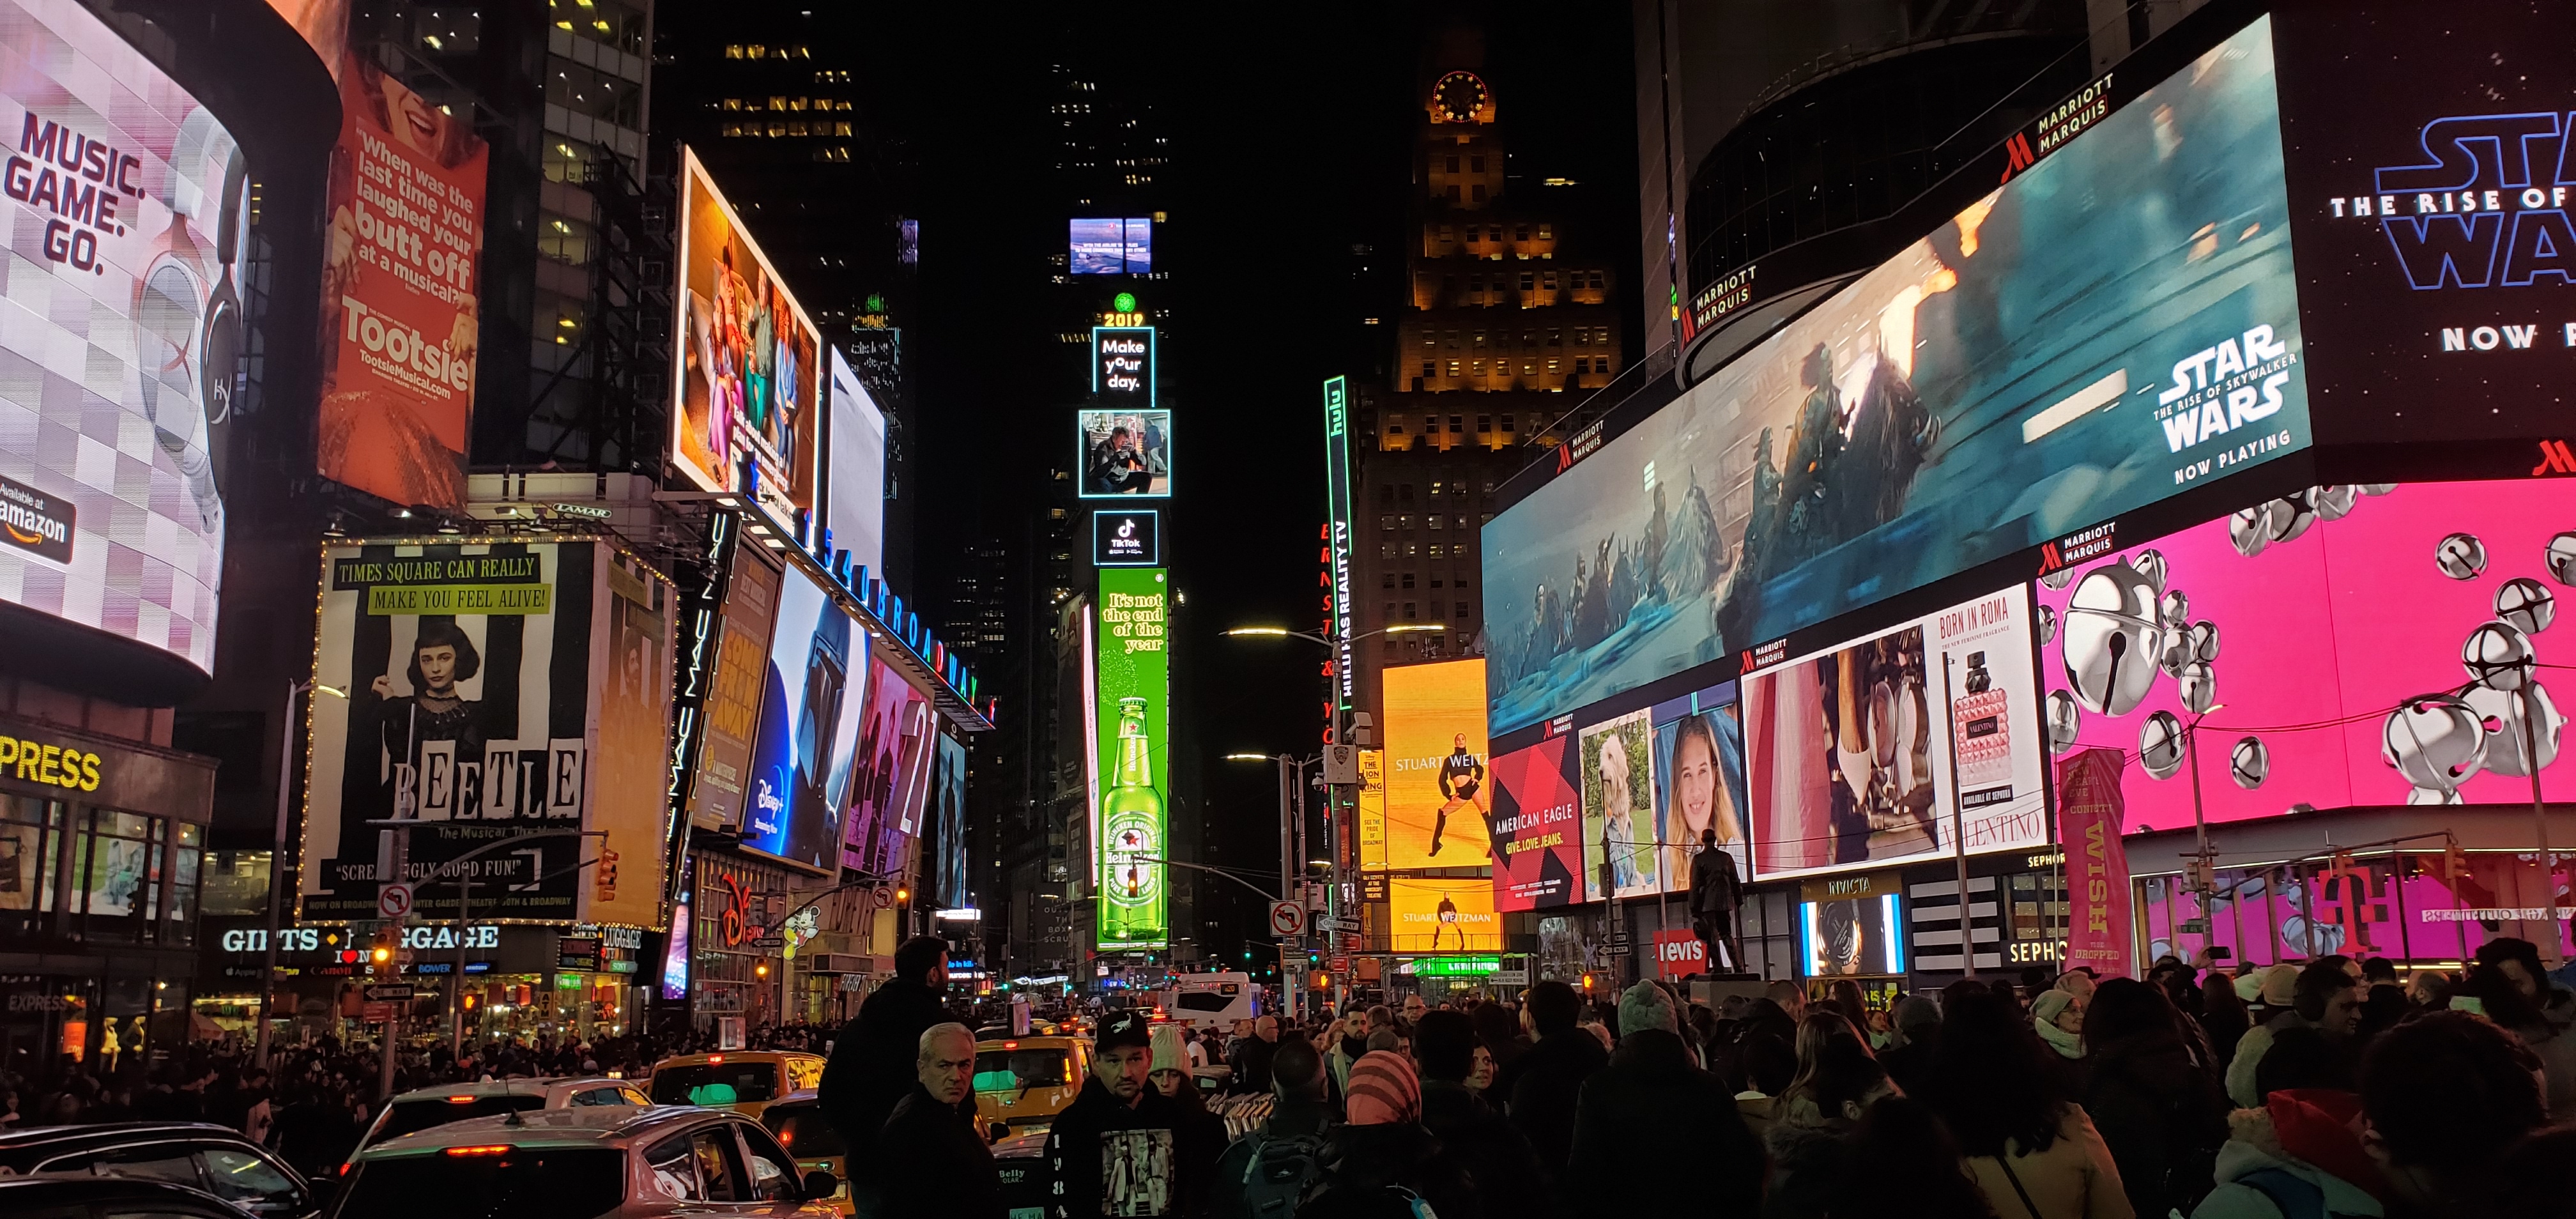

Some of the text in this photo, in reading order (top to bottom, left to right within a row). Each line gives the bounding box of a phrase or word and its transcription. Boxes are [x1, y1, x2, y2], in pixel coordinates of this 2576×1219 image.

[2039, 72, 2114, 135] MARRIOTT
[2039, 95, 2108, 154] MARQUIS
[20, 111, 146, 200] MUSIC.
[4, 155, 125, 238] GAME.
[359, 151, 473, 236] last time you
[416, 167, 445, 197] was
[449, 185, 473, 215] the
[2332, 187, 2567, 218] THE RISE OF
[357, 175, 471, 256] laughed your
[44, 218, 103, 276] GO.
[355, 199, 470, 291] butt off
[359, 244, 390, 272] at a
[1696, 265, 1757, 310] MARRIOTT
[1697, 285, 1751, 328] MARQUIS
[1104, 314, 1144, 327] 2019
[342, 294, 468, 392] Tootsie
[1102, 339, 1146, 354] Make
[2442, 325, 2538, 353] NOW
[360, 349, 451, 400] TootsieMusical.com
[1105, 356, 1142, 374] your
[2159, 323, 2286, 407] STAR
[1108, 373, 1140, 392] day.
[2154, 353, 2298, 422] THE RISE OF SKYWALKER
[1330, 390, 1343, 437] hulu
[2161, 369, 2290, 454] WARS
[733, 403, 780, 467] Talk about making
[1572, 419, 1604, 450] MARRIOTT
[1572, 433, 1602, 463] MARQUIS
[733, 425, 746, 448] plan
[762, 456, 790, 493] emergency.
[2174, 429, 2291, 486] NOW PLAYING
[0, 482, 44, 510] Available at
[0, 500, 65, 544] amazon
[558, 504, 606, 517] LAMAR
[1111, 539, 1140, 548] TikTok
[1336, 521, 1348, 543] TV
[2064, 522, 2117, 549] MARRIOTT
[2065, 538, 2112, 563] MARQUIS
[339, 557, 535, 584] TIMES SQUARE CAN REALLY
[1337, 544, 1351, 618] REALITY
[374, 588, 545, 610] MAKE YOU FEEL ALIVE!
[1135, 594, 1163, 608] not
[1320, 523, 1334, 677] ERNST &
[1103, 607, 1163, 622] the end
[1940, 596, 2009, 640] BORN IN ROMA
[877, 580, 977, 706] BROADWAY
[1113, 622, 1163, 637] of the
[1960, 634, 1982, 645] FEMININE
[1982, 625, 2011, 640] FRAGRANCE
[1124, 640, 1164, 655] year
[1756, 639, 1788, 657] MARRIOTT
[1756, 650, 1784, 668] MARQUIS
[1341, 652, 1353, 697] HULU
[1553, 714, 1574, 726] MARRIOTT
[1553, 723, 1572, 735] MARQUIS
[1128, 736, 1137, 772] Heineken
[1396, 756, 1443, 772] STUART
[392, 745, 580, 820] BEETLE
[1963, 788, 2012, 807] AVAILABLE AT SEPHORA
[438, 827, 458, 839] The
[1108, 821, 1158, 845] HEINEKEN ORIGINAL
[1496, 804, 1573, 836] AMERICAN EAGLE
[1506, 832, 1563, 855] GIVE. LOVE. JEANS.
[1108, 877, 1122, 894] PURE
[1828, 877, 1871, 896] INVICTA
[2085, 820, 2108, 933] WISH
[309, 901, 328, 910] NOW
[330, 901, 341, 910] ON
[530, 897, 572, 906] BROADWAY
[1323, 919, 1337, 927] ONE
[1403, 913, 1491, 923] STUART WEITZMAN
[602, 927, 641, 949] LUGGAGE
[418, 963, 451, 973] BOWER
[612, 963, 627, 971] SONY
[2074, 949, 2119, 960] DROPPED
[9, 995, 68, 1011] EXPRESS
[999, 1169, 1025, 1178] Belly
